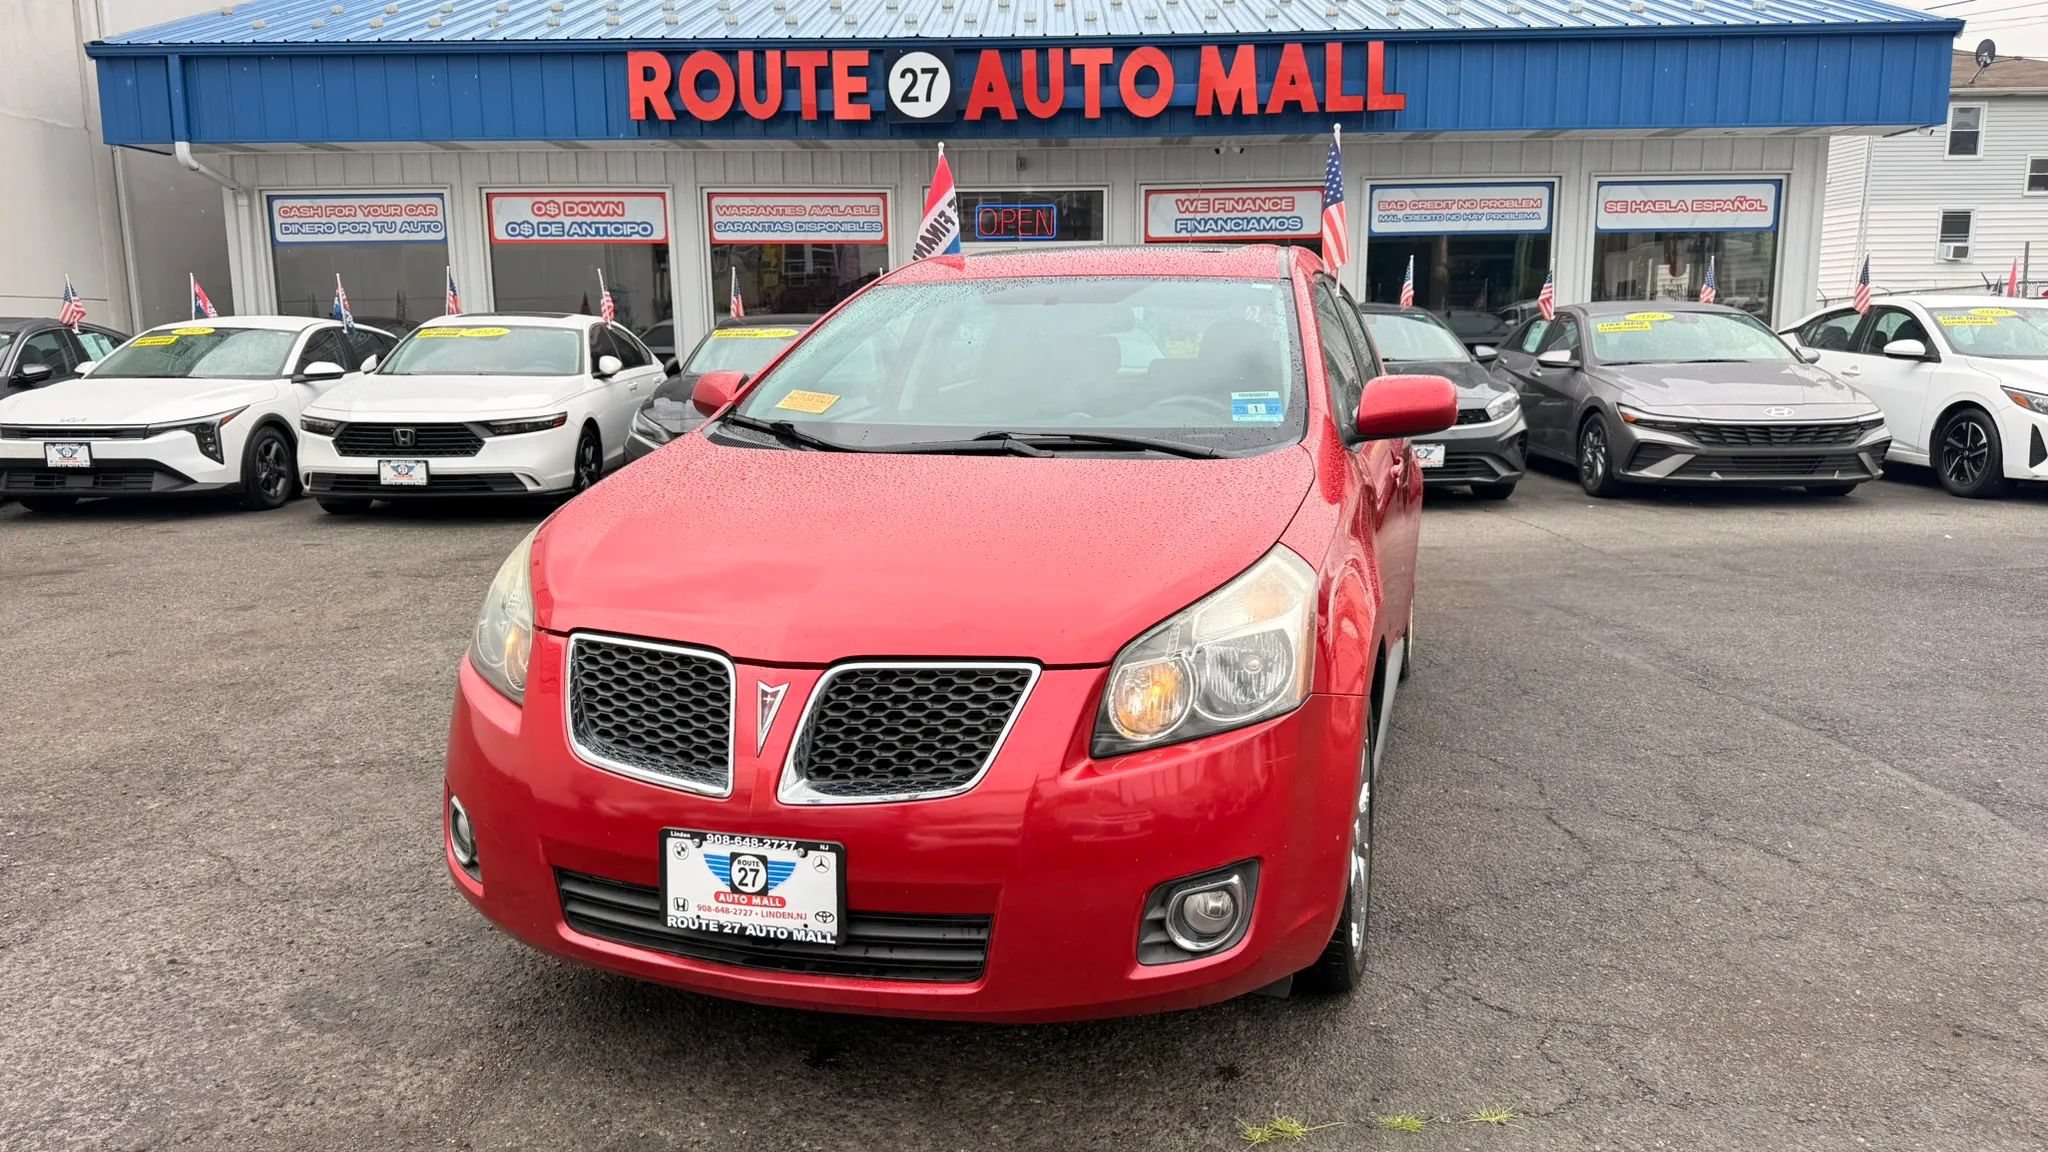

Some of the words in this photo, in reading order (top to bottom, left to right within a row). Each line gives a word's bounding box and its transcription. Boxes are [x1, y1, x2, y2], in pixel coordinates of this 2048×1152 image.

[627, 49, 871, 121] ROUTE
[900, 67, 940, 103] 27
[964, 45, 1175, 120] AUTO
[1195, 40, 1406, 116] MALL
[278, 206, 323, 218] CASH
[324, 205, 357, 217] FOR
[358, 204, 402, 217] YOUR
[405, 204, 438, 216] CAR
[563, 201, 625, 217] DOWN
[715, 205, 806, 217] WARRANTIES
[808, 205, 880, 217] AVAILABLE
[1176, 198, 1211, 214] WE
[1212, 196, 1295, 213] FINANCE
[1378, 200, 1407, 212] BAD
[1409, 199, 1456, 211] CREDIT
[1457, 199, 1478, 210] NO
[1479, 198, 1542, 210] PROBLEM
[1605, 200, 1629, 213] SE
[1630, 199, 1688, 213] HABLA
[1690, 195, 1768, 213] ESPAÑOL
[979, 208, 1054, 236] OPEN
[1175, 216, 1303, 234] FINANCIAMOS
[1378, 214, 1401, 223] MAL
[1402, 213, 1445, 223] CREDITO
[1446, 213, 1461, 222] NO
[1462, 213, 1485, 222] HAY
[1486, 212, 1541, 222] PROBLEMA
[280, 222, 336, 235] DINERO
[338, 222, 371, 234] POR
[373, 221, 397, 234] TU
[399, 220, 443, 233] AUTO
[537, 222, 565, 237] DE
[567, 221, 654, 237] ANTICIPO
[714, 221, 792, 233] GARANTIAS
[795, 221, 883, 233] DISPONIBLES
[670, 830, 691, 838] Linden
[706, 833, 797, 852] 908-648-2727
[737, 859, 760, 868] ROUTE
[737, 867, 760, 888] 27
[718, 893, 750, 905] AUTO
[752, 896, 782, 907] MALL
[697, 904, 753, 917] 908-648-2727
[761, 910, 808, 921] LINDEN,NJ
[667, 915, 719, 932] ROUTE
[723, 922, 741, 935] 27
[745, 924, 788, 940] AUTO
[792, 928, 836, 944] MALL
